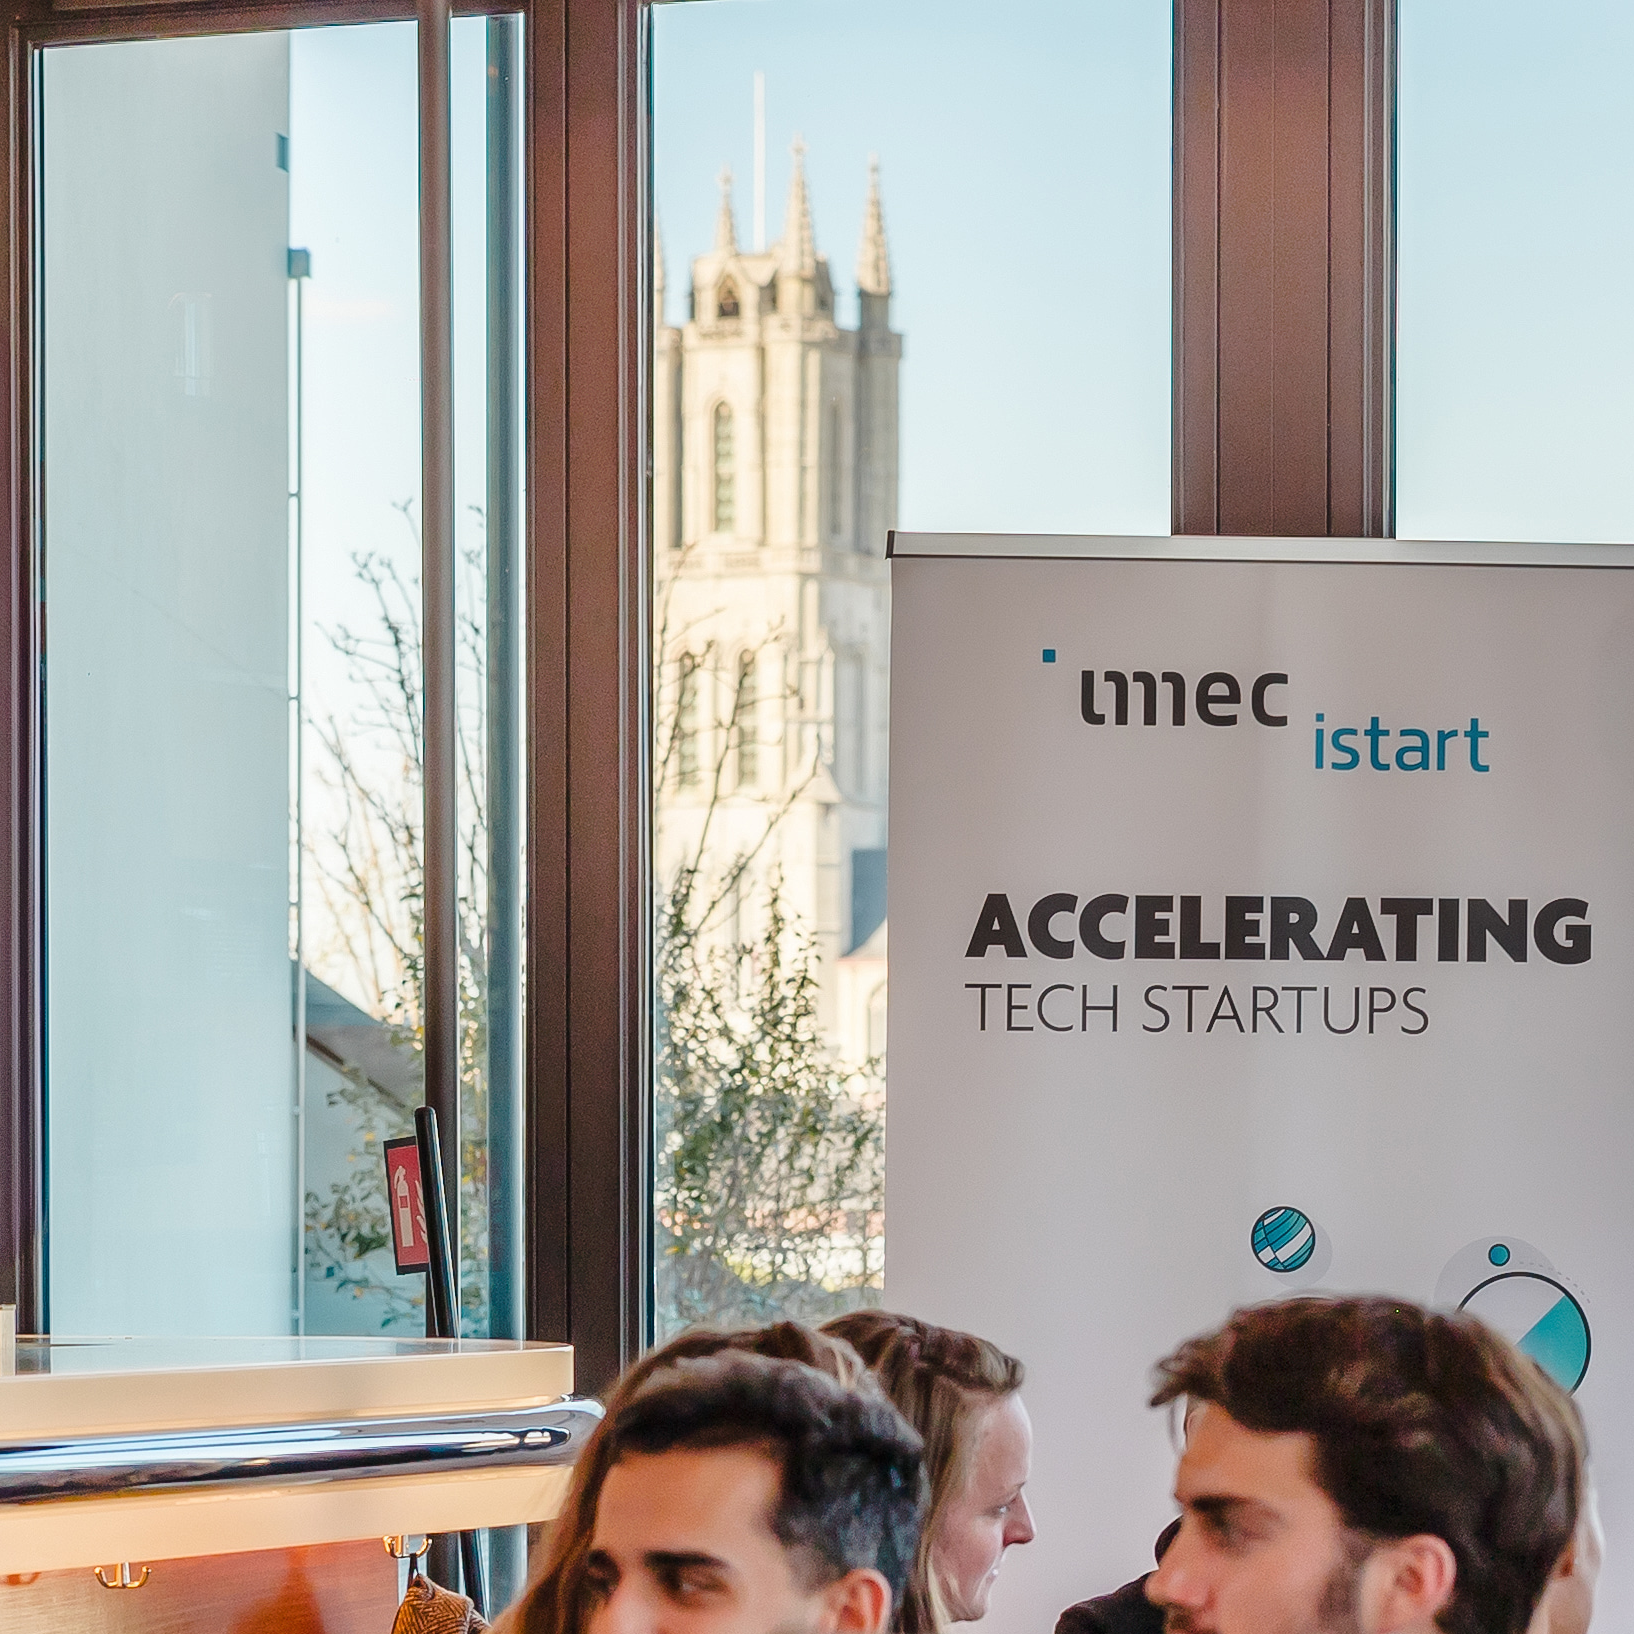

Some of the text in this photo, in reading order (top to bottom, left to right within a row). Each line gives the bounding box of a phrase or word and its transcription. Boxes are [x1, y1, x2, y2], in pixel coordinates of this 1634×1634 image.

[1080, 669, 1289, 728] imec
[1315, 712, 1490, 773] istart
[964, 892, 1593, 965] ACCELERATING
[964, 983, 1430, 1035] TECH STARTUPS
